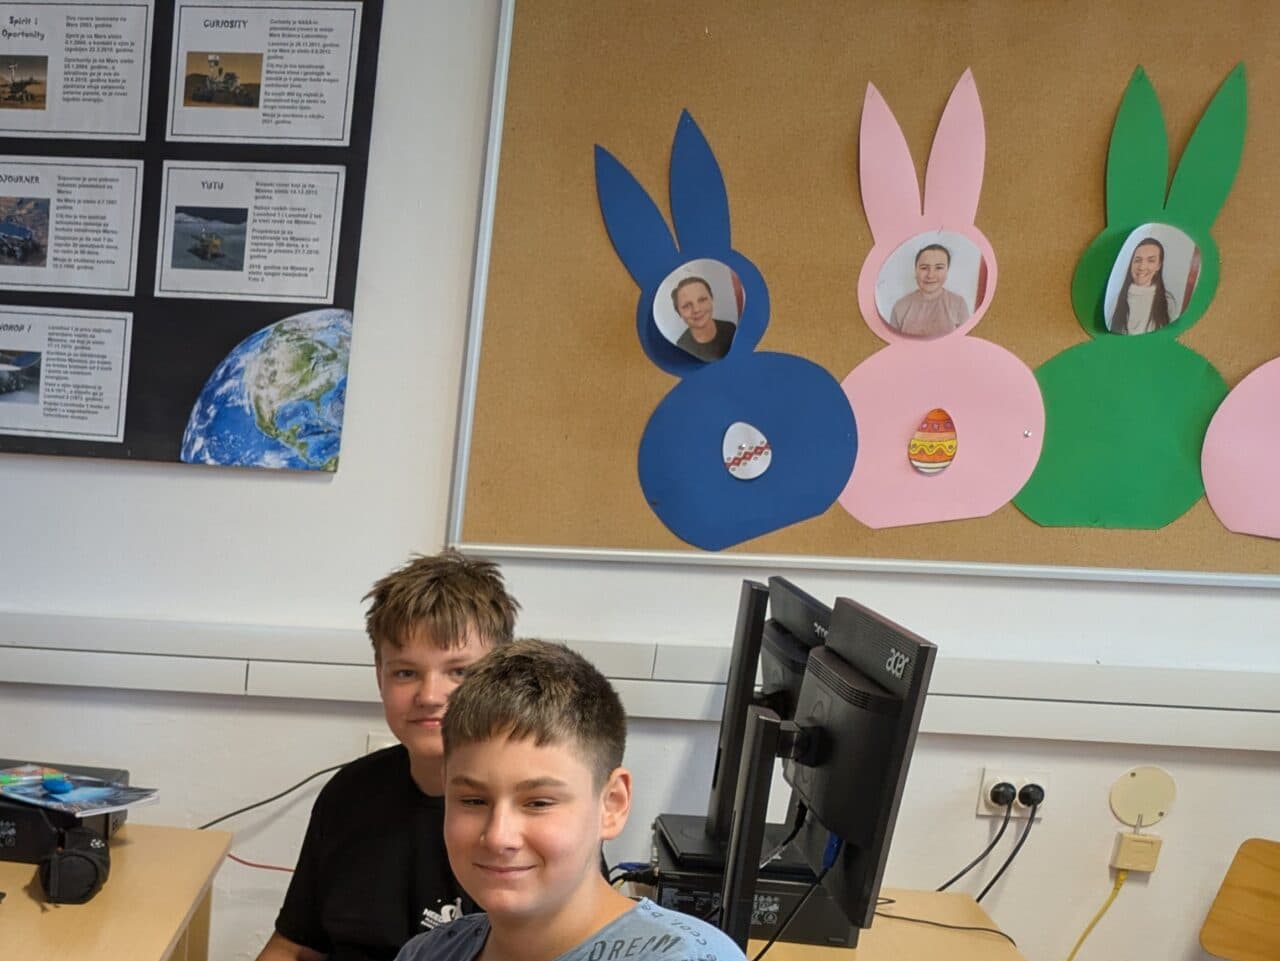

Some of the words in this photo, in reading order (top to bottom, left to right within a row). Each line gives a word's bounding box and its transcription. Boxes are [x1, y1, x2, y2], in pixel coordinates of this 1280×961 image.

[8, 15, 31, 26] Spirit
[203, 19, 249, 30] CURIOSITY
[201, 181, 225, 191] YUTU
[884, 647, 913, 680] acer
